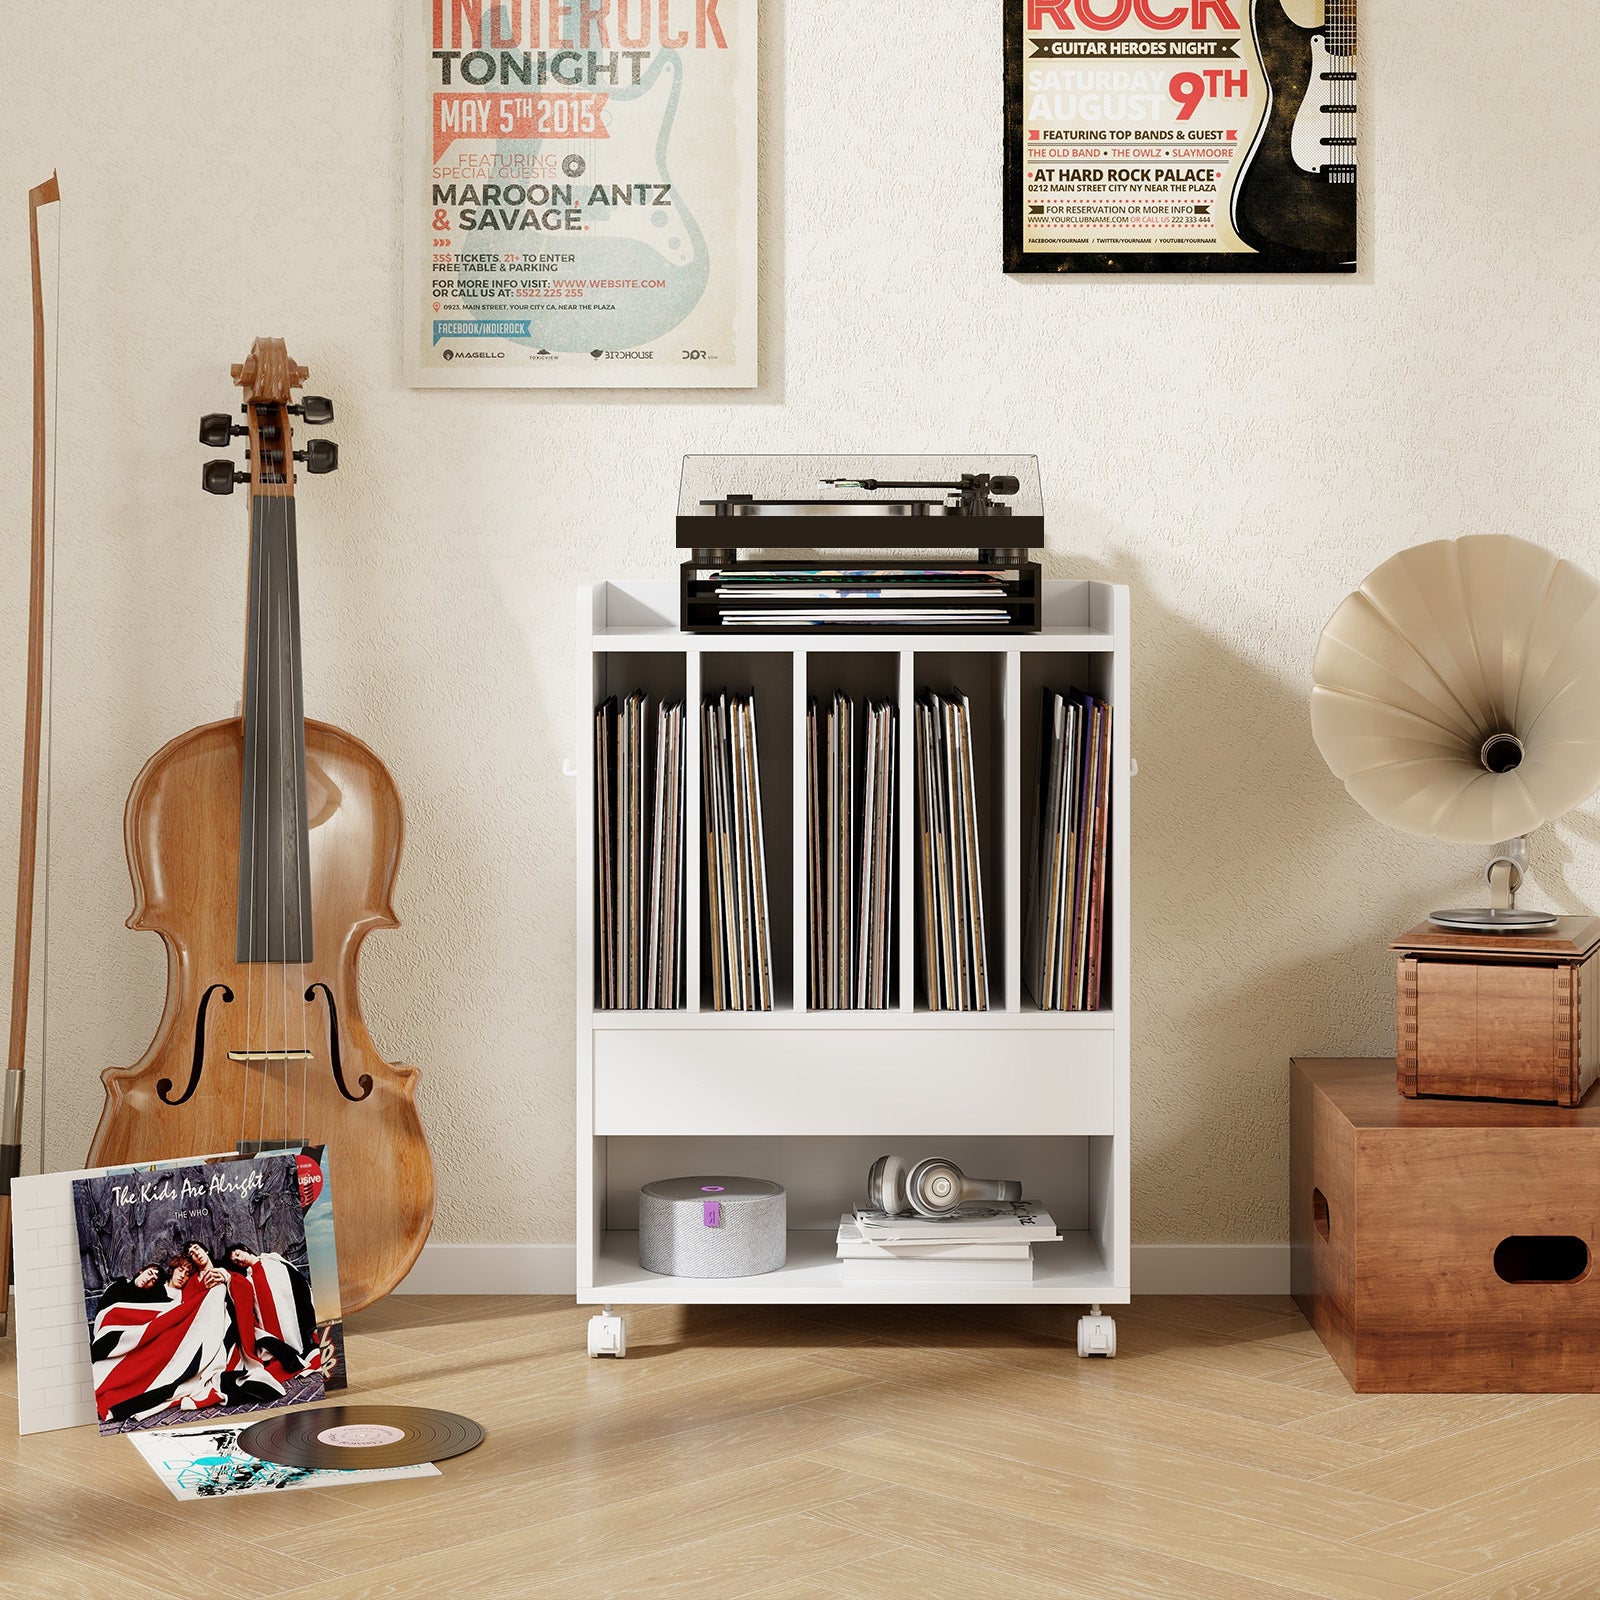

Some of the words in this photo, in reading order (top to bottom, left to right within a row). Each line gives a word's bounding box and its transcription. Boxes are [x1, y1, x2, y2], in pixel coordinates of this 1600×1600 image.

[1052, 42, 1107, 55] GUITAR
[1110, 42, 1166, 55] HEROES
[1169, 42, 1217, 55] NIGHT
[432, 52, 651, 85] TONIGHT
[1028, 70, 1165, 92] SATURDAY
[1168, 69, 1248, 121] 9TH
[1028, 94, 1167, 122] AUGUST
[441, 100, 491, 133] MAY
[501, 98, 532, 133] 5TH
[538, 100, 595, 133] 2015
[1043, 130, 1107, 141] FEATURING
[1110, 130, 1131, 141] TOP
[1134, 130, 1174, 141] BANDS
[1176, 130, 1185, 141] &
[1188, 130, 1223, 141] GUEST
[1028, 149, 1046, 158] THE
[1049, 149, 1068, 158] OLD
[1072, 149, 1101, 158] BAND
[1112, 149, 1129, 158] THE
[1132, 149, 1162, 158] OWLZ
[1172, 149, 1233, 158] SLAYMOORE
[458, 154, 557, 167] FEATURING
[432, 168, 493, 179] SPECIAL
[499, 168, 556, 179] GUESTS
[1034, 169, 1055, 182] AT
[1059, 169, 1103, 182] HARD
[1108, 169, 1151, 182] ROCK
[1155, 169, 1214, 182] PALACE
[432, 184, 580, 208] MAROON,
[588, 184, 672, 206] ANTZ
[1046, 206, 1064, 214] FOR
[1066, 206, 1126, 214] RESERVATION
[1128, 206, 1141, 214] OR
[1143, 206, 1169, 214] MORE
[1171, 206, 1193, 214] INFO
[432, 208, 451, 231] &
[458, 208, 590, 231] SAVAGE.
[432, 254, 452, 263] 35$
[504, 254, 520, 263] 21+
[523, 254, 536, 263] TO
[540, 254, 575, 263] ENTER
[432, 264, 460, 272] FREE
[463, 264, 496, 272] TABLE
[500, 264, 507, 272] &
[509, 264, 558, 272] PARKING
[432, 280, 455, 288] FOR
[458, 280, 489, 288] MORE
[492, 280, 518, 288] INFO
[520, 280, 551, 288] VISIT:
[552, 280, 666, 288] WWW.WEBSITE.COM
[432, 289, 448, 297] OR
[451, 289, 479, 297] CALL
[480, 289, 495, 297] US
[498, 289, 514, 297] AT:
[516, 289, 541, 297] 5522
[544, 289, 562, 297] 225
[565, 289, 583, 297] 255
[438, 324, 525, 334] FACEBOOK/INDIEROCK
[605, 351, 654, 359] BIRDHOUSE
[298, 1174, 321, 1185] usive
[112, 1186, 137, 1207] The
[140, 1181, 178, 1203] Kids
[181, 1178, 207, 1199] Are
[209, 1170, 264, 1199] Alright
[175, 1211, 187, 1220] THE
[190, 1208, 209, 1218] WHO
